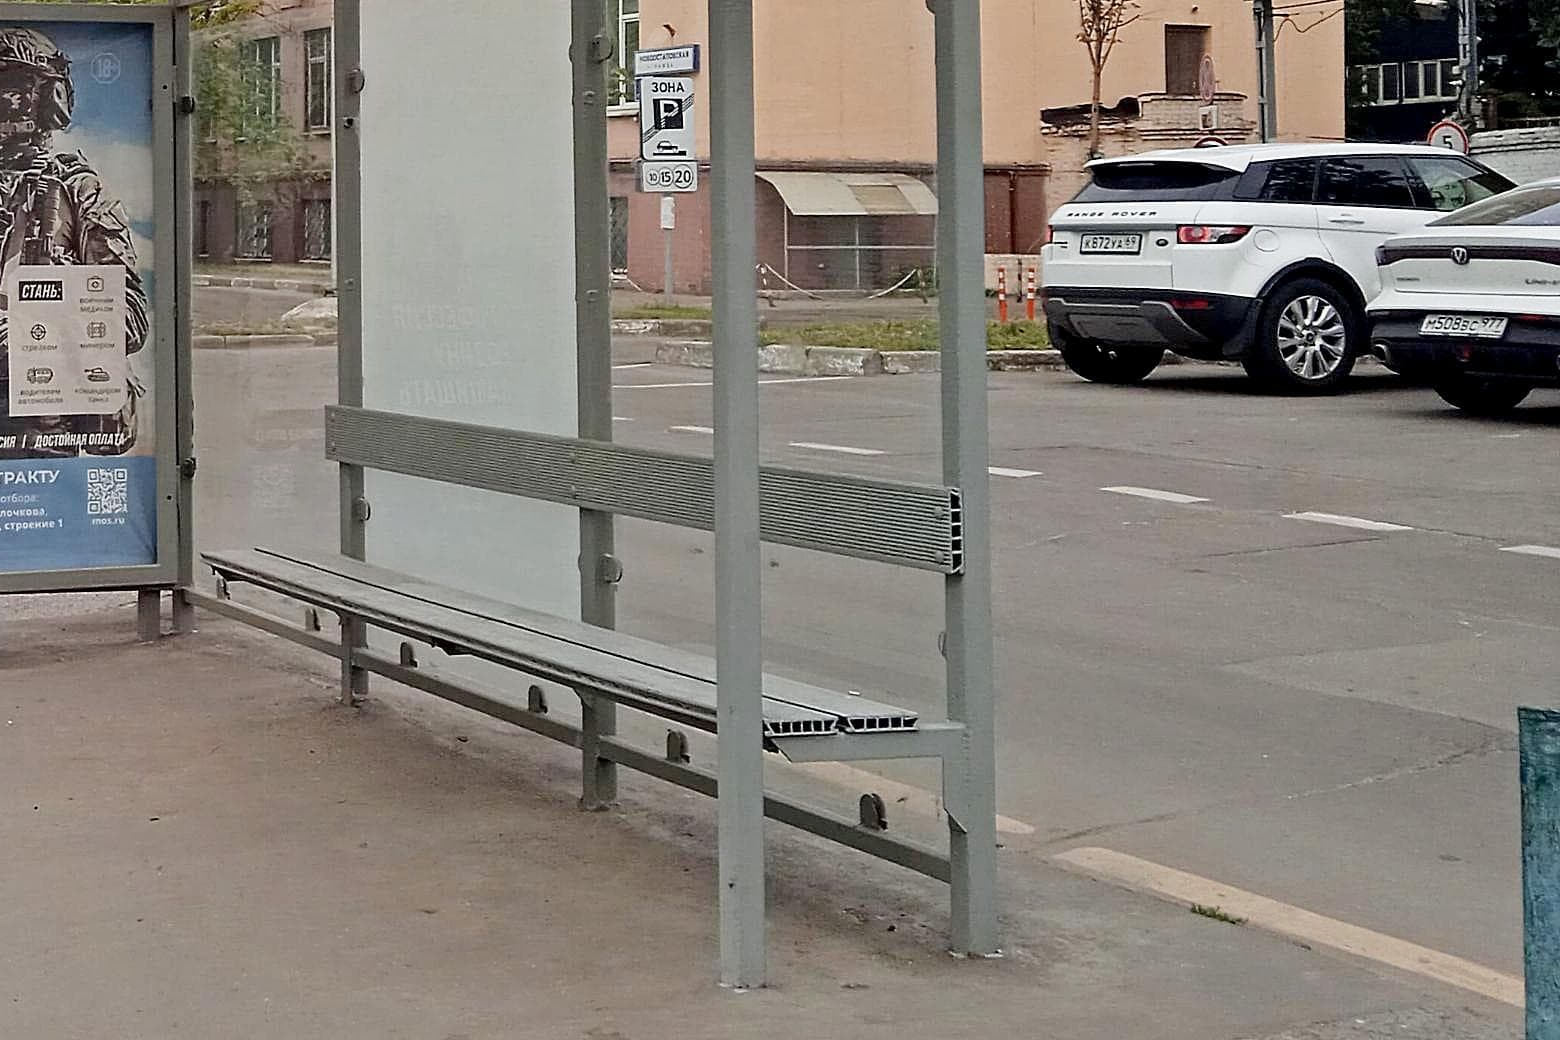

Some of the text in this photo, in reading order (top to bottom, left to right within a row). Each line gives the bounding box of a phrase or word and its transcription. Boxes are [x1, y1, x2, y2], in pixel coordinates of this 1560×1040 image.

[651, 81, 685, 93] ЗОНА
[1442, 135, 1453, 149] 5
[660, 171, 672, 183] 15
[674, 170, 691, 184] 20
[21, 283, 62, 299] СТАНЬ:
[34, 432, 88, 449] ДОСТОЙНАЯ
[88, 432, 126, 446] ОПЛАТА
[4, 521, 55, 532] строение
[58, 518, 64, 528] 1
[91, 517, 125, 526] mos.ru
